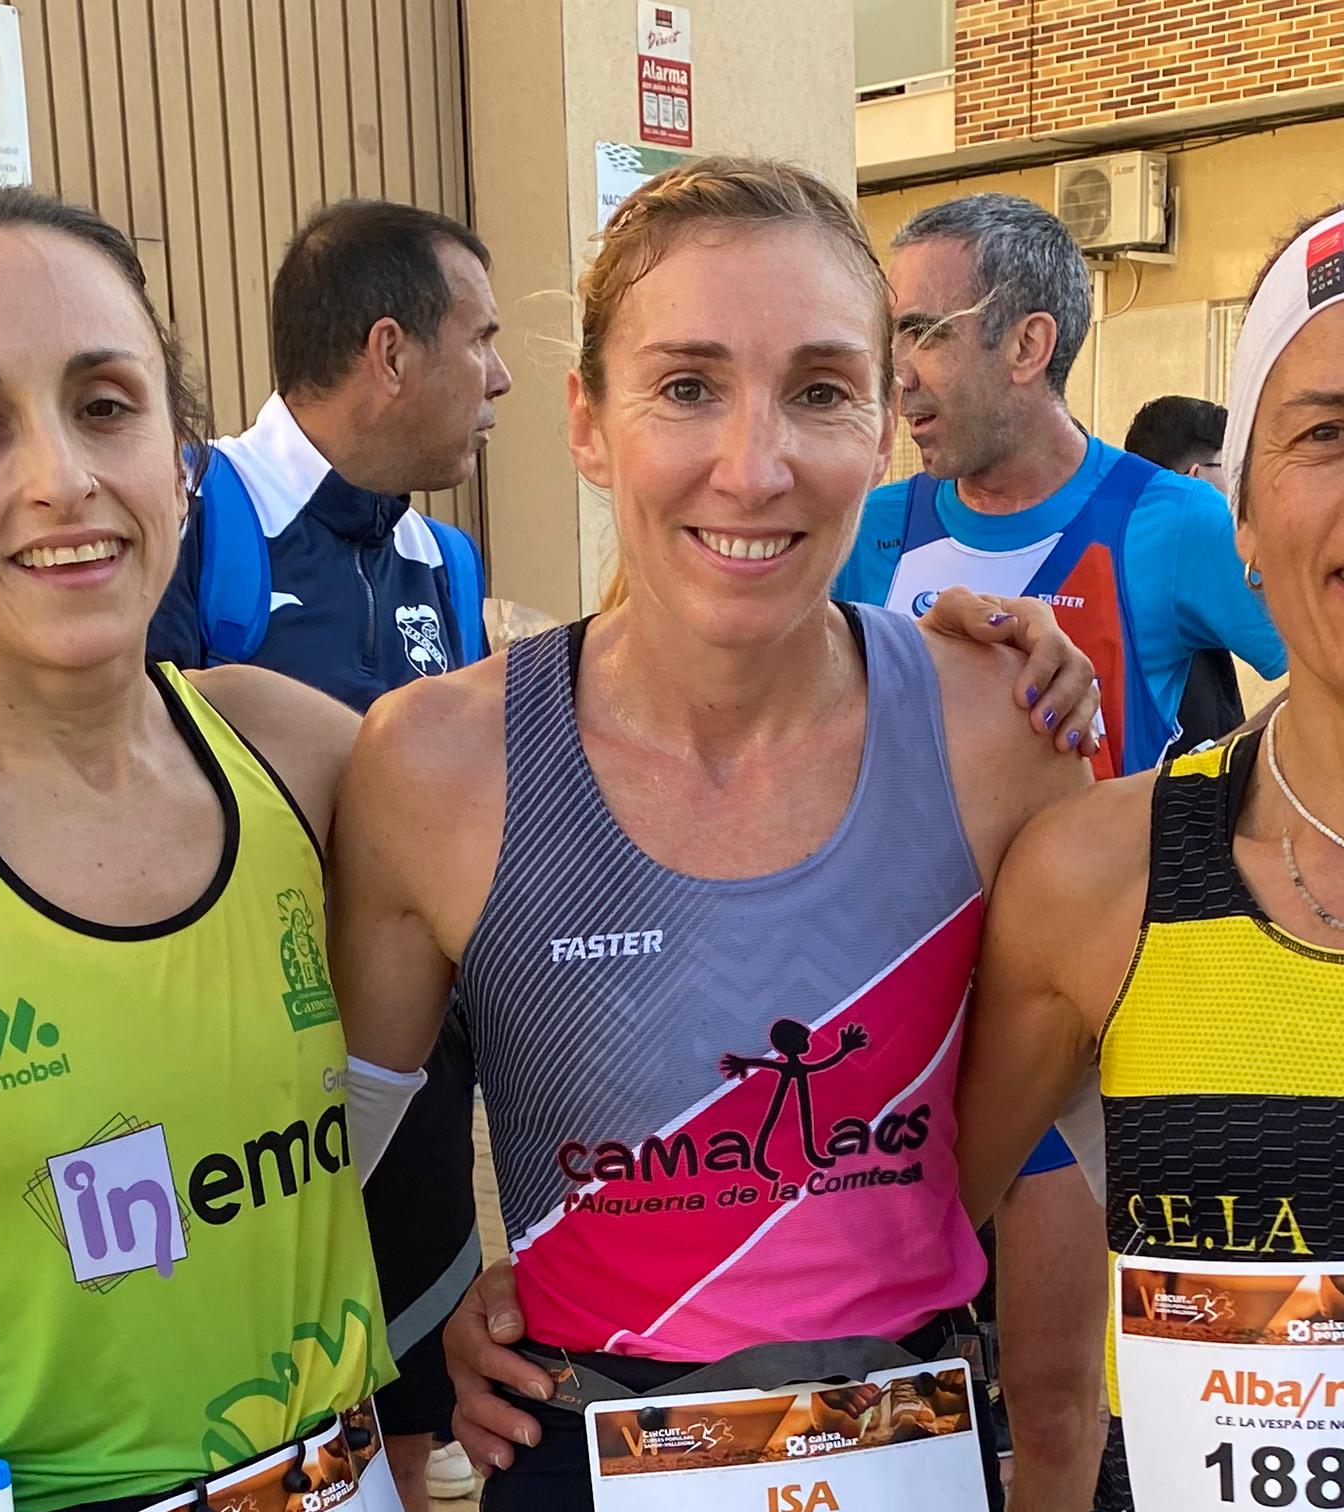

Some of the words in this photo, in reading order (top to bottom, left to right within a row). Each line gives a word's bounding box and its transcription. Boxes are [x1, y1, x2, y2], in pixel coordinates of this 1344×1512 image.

[642, 60, 688, 85] Alarma
[1038, 593, 1085, 608] FASTER
[550, 929, 664, 962] FASTER
[718, 1184, 759, 1207] de
[769, 1181, 801, 1202] la
[1239, 1418, 1256, 1428] LA
[1258, 1419, 1303, 1430] VESPA
[1307, 1420, 1326, 1430] DE
[643, 1428, 681, 1439] CIRCUIT
[808, 1432, 841, 1444] caixa
[809, 1437, 859, 1453] popular
[321, 1480, 345, 1497] caixa
